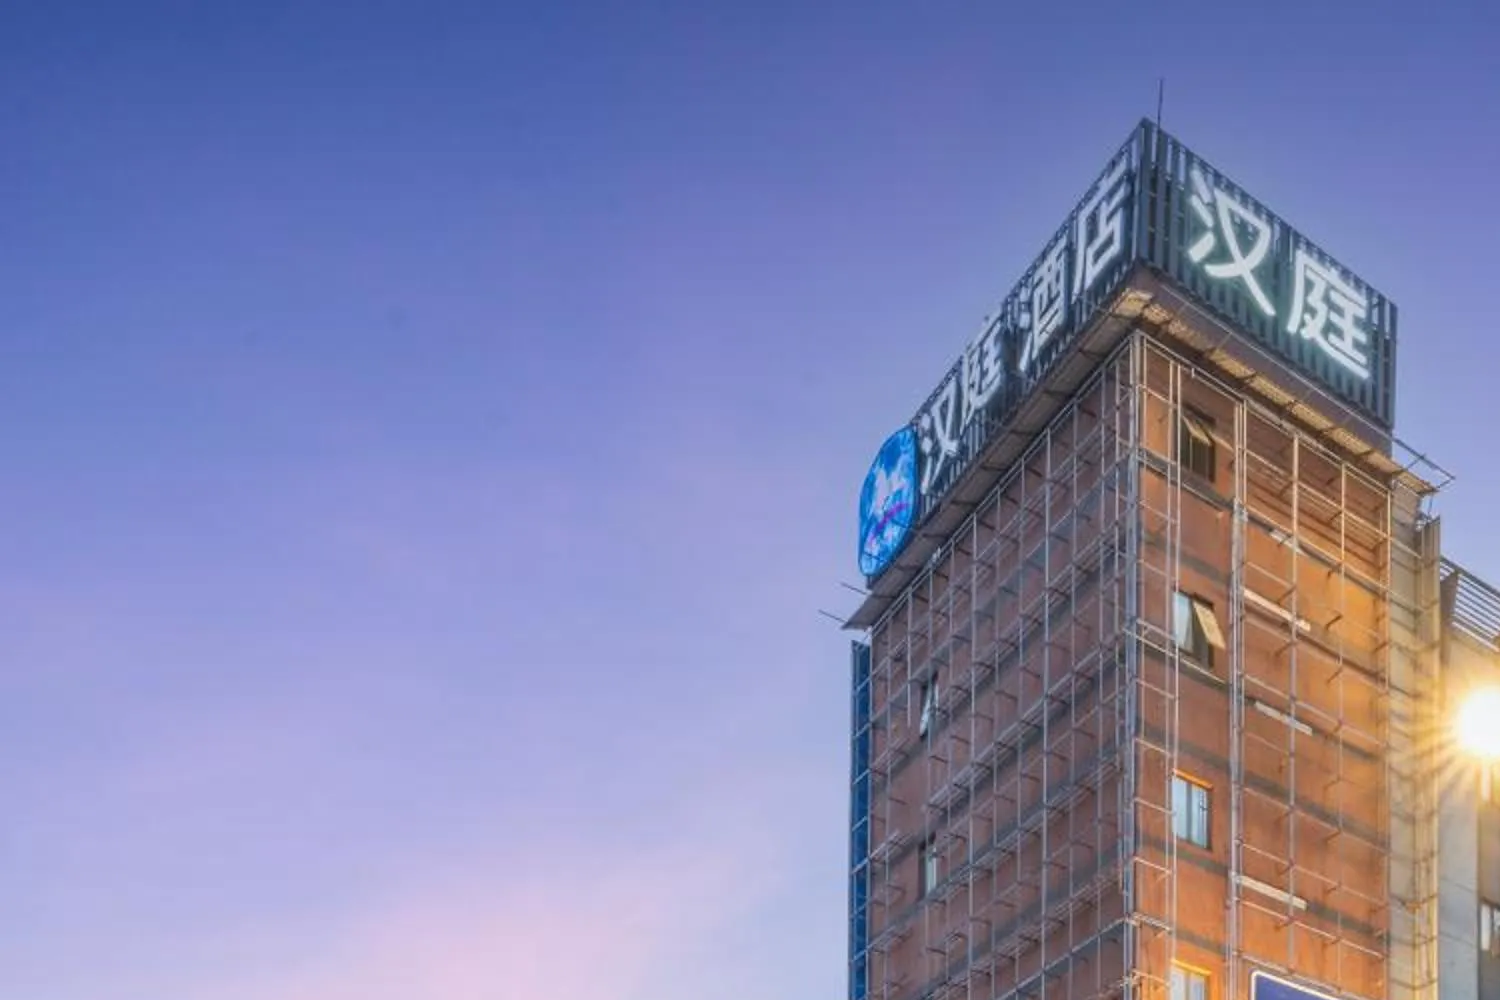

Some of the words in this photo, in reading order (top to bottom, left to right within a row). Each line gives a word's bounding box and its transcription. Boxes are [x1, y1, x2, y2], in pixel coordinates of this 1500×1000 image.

[919, 162, 1127, 494] 汉庭酒店
[1188, 170, 1371, 380] 汉庭
